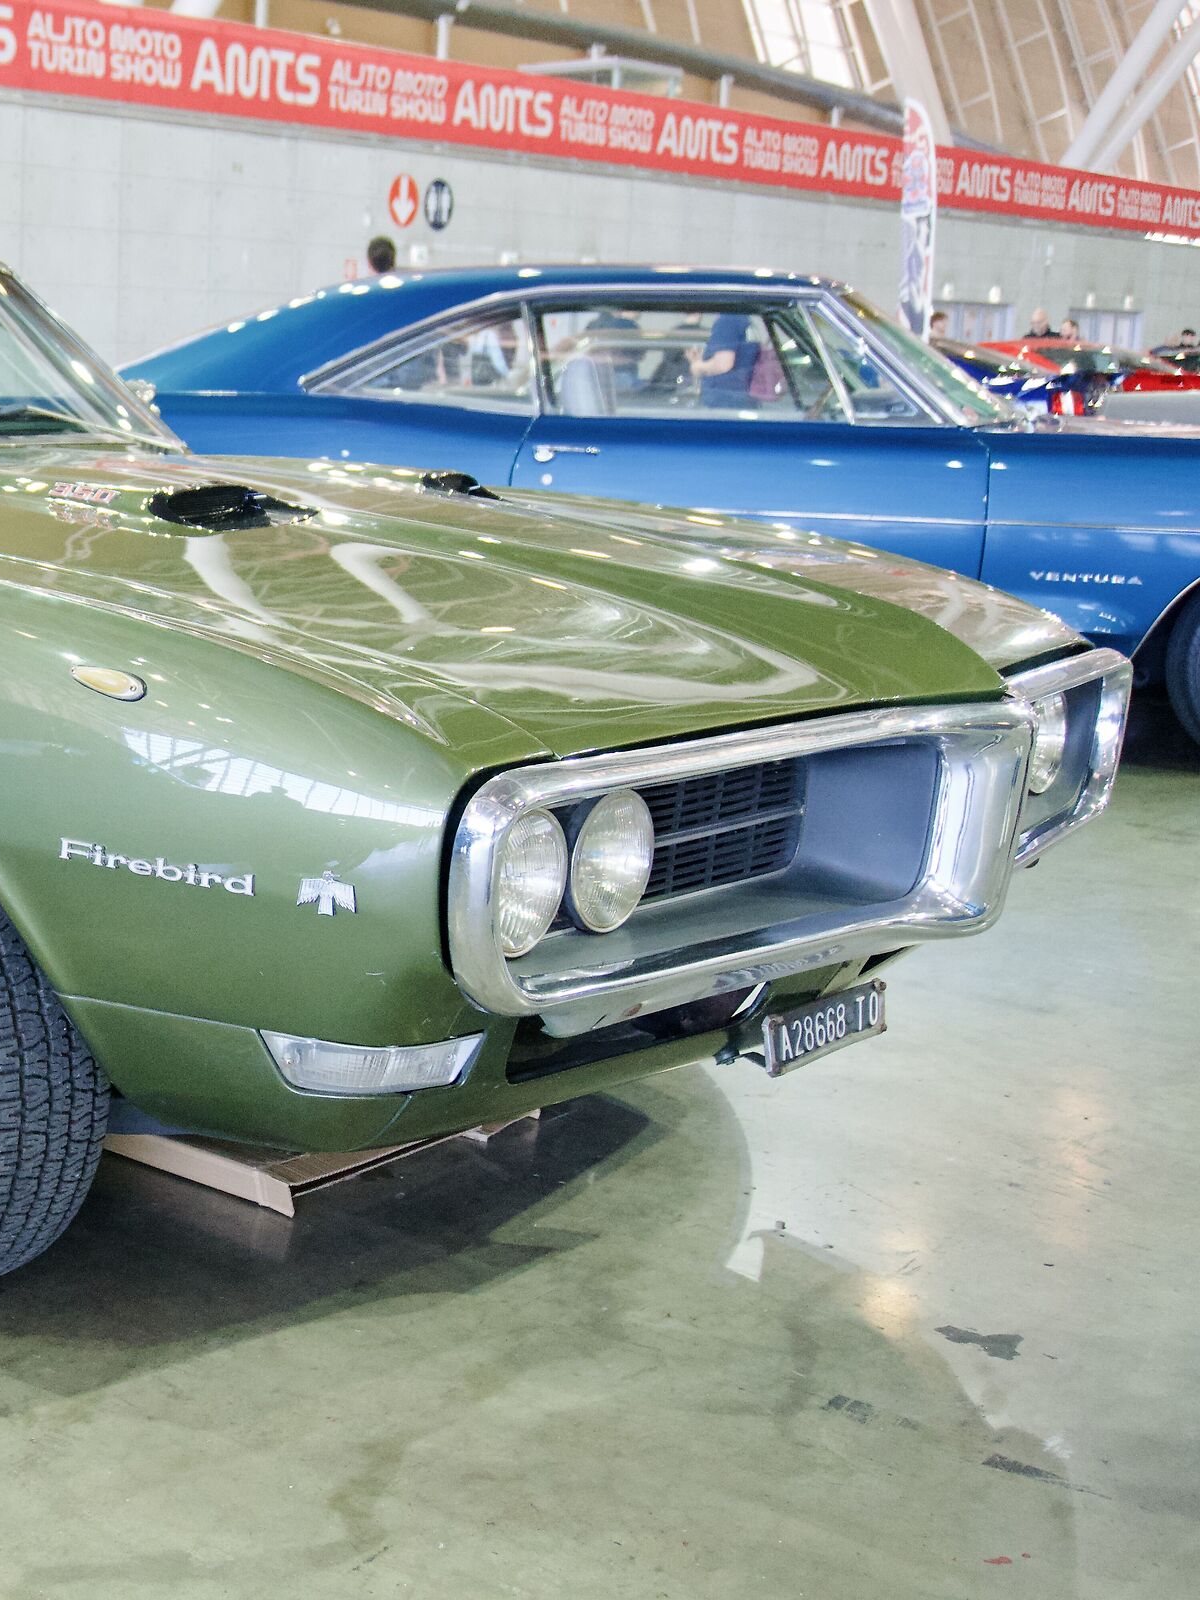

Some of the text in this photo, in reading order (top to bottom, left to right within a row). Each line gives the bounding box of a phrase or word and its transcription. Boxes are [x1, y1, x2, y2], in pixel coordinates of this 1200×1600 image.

[27, 10, 182, 59] AUTO MOTO
[27, 40, 182, 89] TURIN SHOW
[191, 38, 321, 106] AMTS
[329, 59, 449, 99] AUTO MOTO
[328, 84, 447, 125] TURIN SHOW
[453, 80, 553, 137] AMTS
[560, 96, 608, 122] AUTO
[657, 112, 739, 165] AMTS
[820, 140, 889, 186] AMTS
[1029, 571, 1143, 586] VENTURA
[59, 836, 256, 897] Firebird
[781, 991, 879, 1062] A28668 TO
